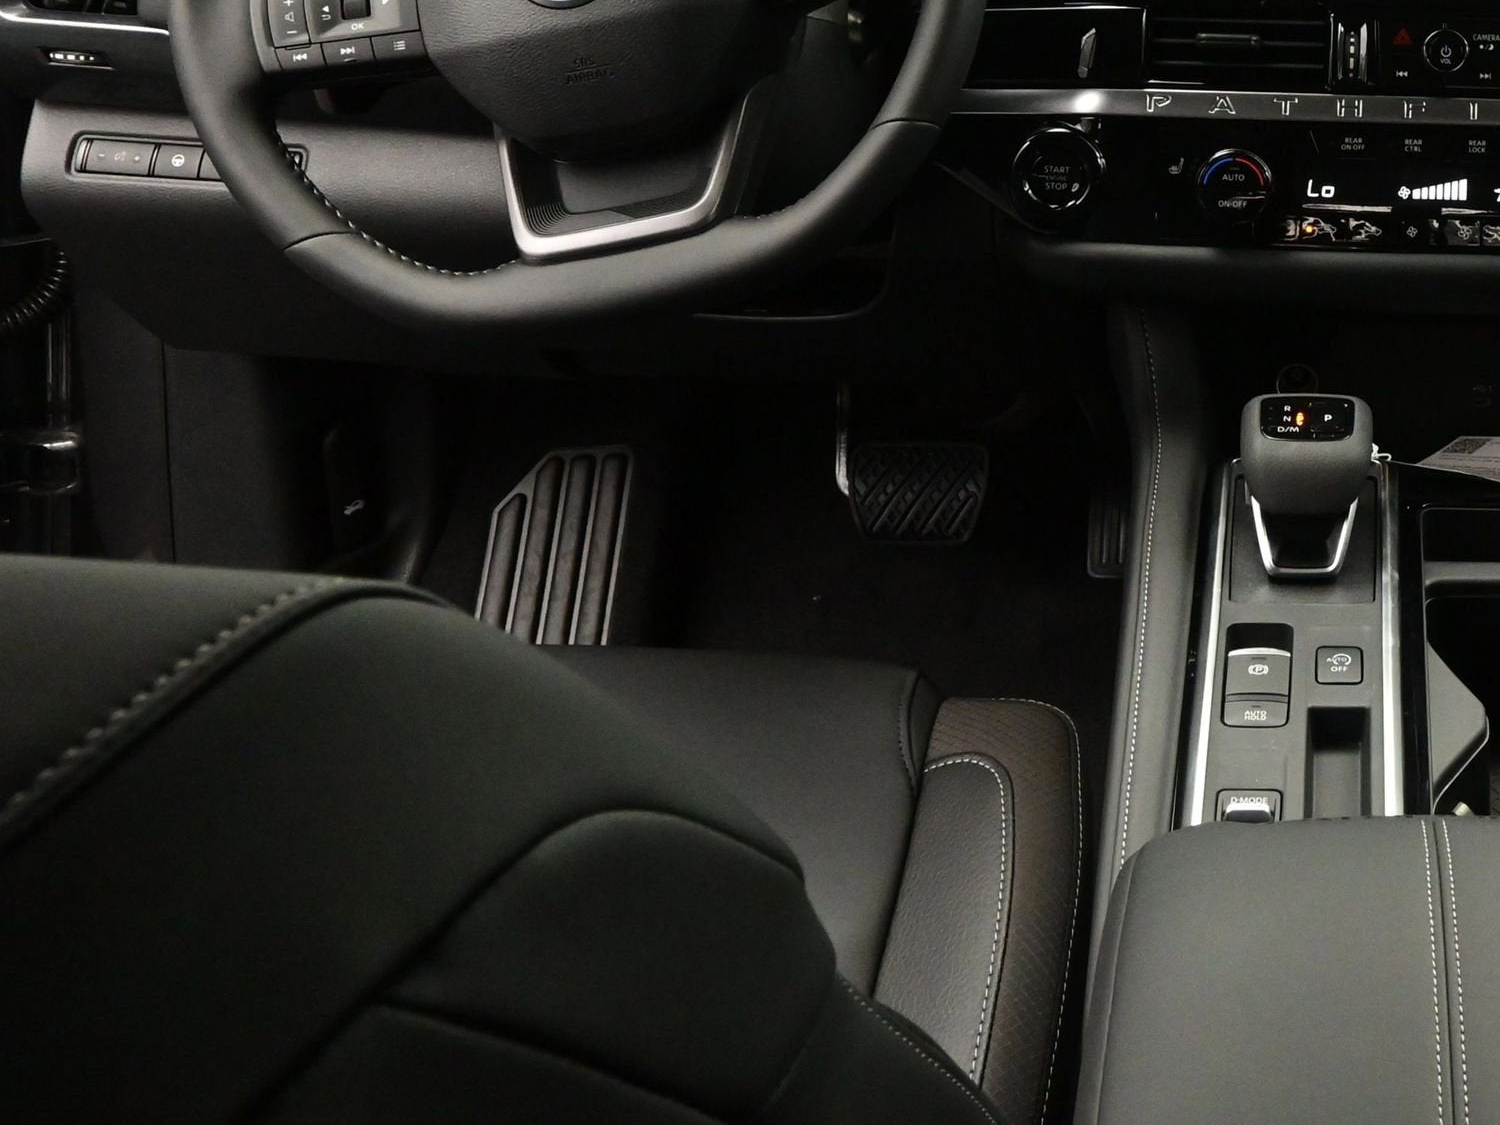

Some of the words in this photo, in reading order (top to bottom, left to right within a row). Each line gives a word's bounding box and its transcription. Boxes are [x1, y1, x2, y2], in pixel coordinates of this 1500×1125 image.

[351, 22, 364, 31] OK
[1472, 33, 1500, 42] CAMERA
[1440, 57, 1452, 65] VOL
[1344, 136, 1363, 144] REAR
[1404, 138, 1423, 146] REAR
[1468, 139, 1487, 147] REAR
[1404, 145, 1422, 153] CTRL
[1468, 146, 1486, 154] LOCK
[1044, 165, 1070, 173] START
[1222, 173, 1246, 182] AUTO
[1045, 182, 1068, 191] STOP
[1306, 179, 1335, 199] Lo
[1283, 405, 1292, 413] R
[1282, 415, 1292, 423] N
[1323, 414, 1333, 423] P
[1276, 425, 1300, 433] D/M
[1330, 665, 1348, 674] OFF
[1244, 714, 1268, 722] HOLD
